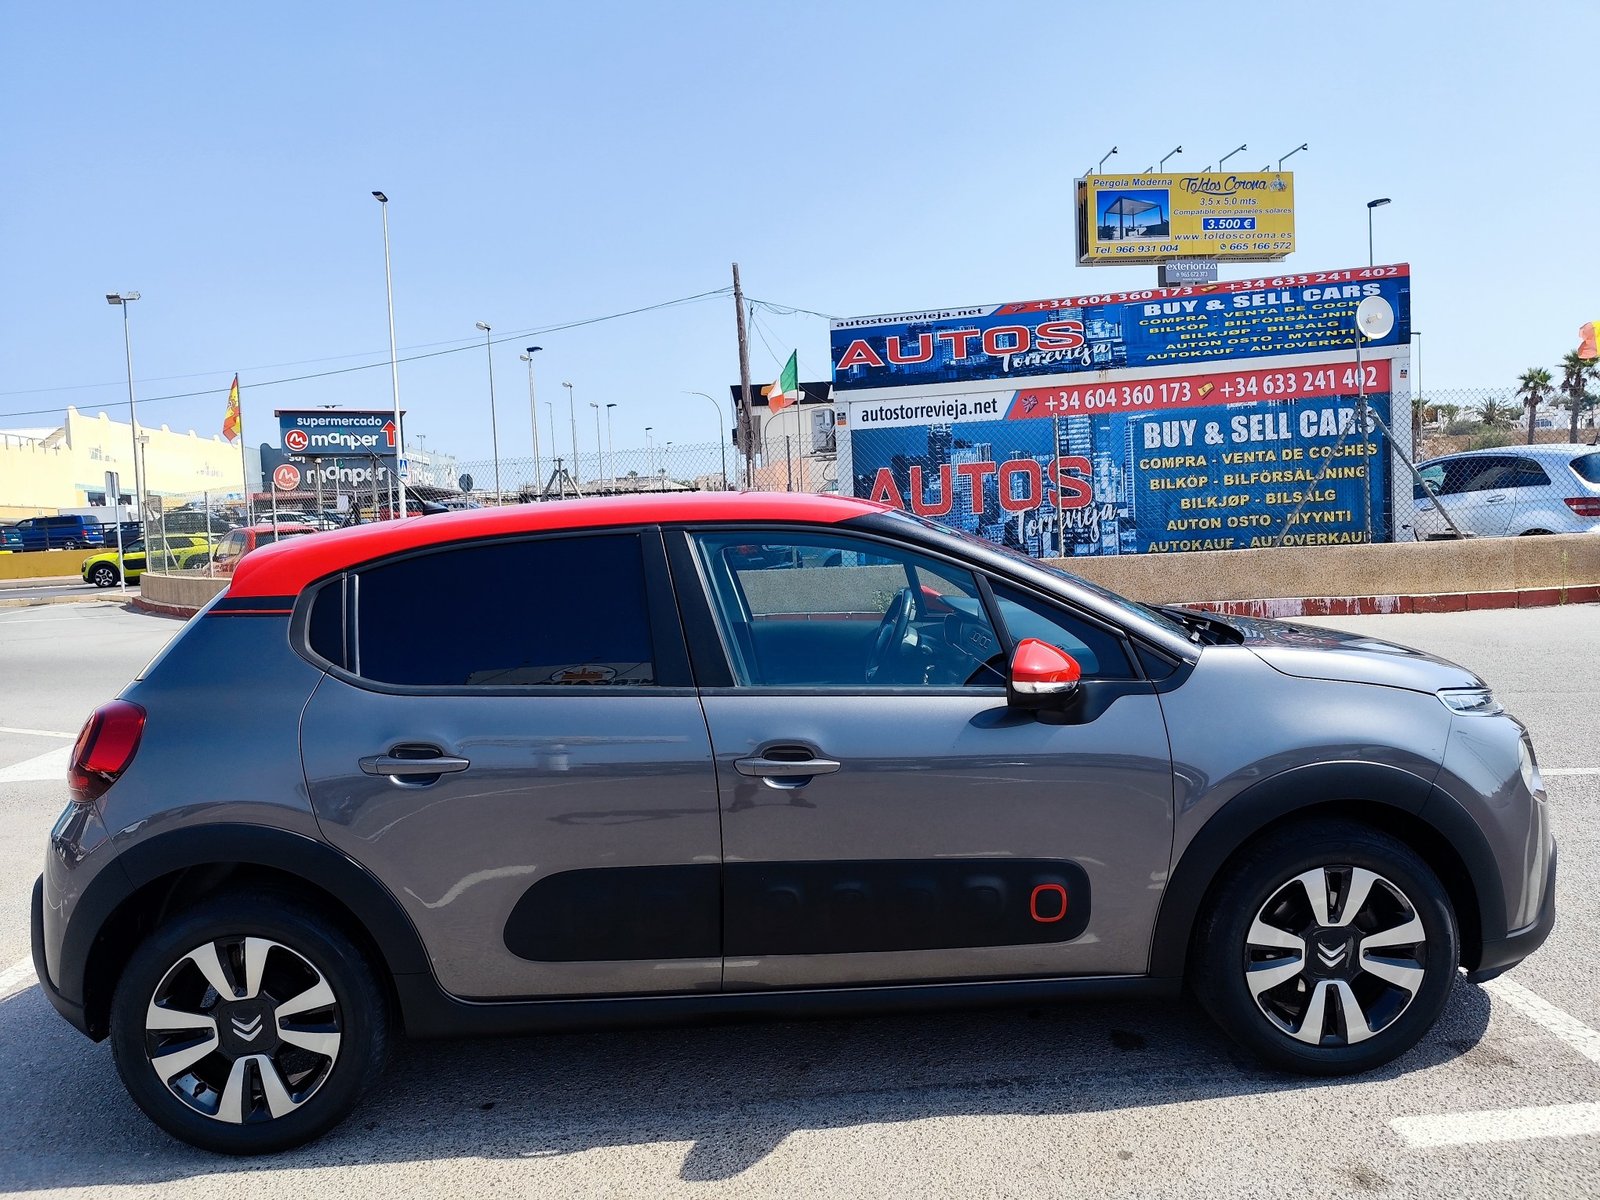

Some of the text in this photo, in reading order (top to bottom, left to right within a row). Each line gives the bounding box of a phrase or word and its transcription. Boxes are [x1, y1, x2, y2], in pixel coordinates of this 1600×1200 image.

[1132, 178, 1173, 186] Moderna
[1179, 175, 1267, 194] Toldos Corona
[1239, 197, 1259, 205] mts.
[1207, 219, 1252, 229] 3.500 €
[1174, 231, 1292, 240] www.toldoscorona.es
[1094, 244, 1179, 254] Tel. 966 931 004
[1229, 241, 1292, 250] 665 166 572
[1166, 261, 1217, 271] exterioriza
[1035, 267, 1398, 310] +34 604 360 173 +34 633 241 402
[1144, 283, 1381, 317] BUY & SELL CARS
[836, 308, 983, 328] autostorrevieja.net
[1139, 314, 1208, 326] COMPRA
[1223, 308, 1278, 318] VENTA
[1284, 305, 1305, 313] DE
[1312, 301, 1360, 310] COCH
[1149, 323, 1209, 334] BILKÖP
[1181, 328, 1251, 340] BILKJØP
[1267, 321, 1339, 332] BILSALG
[836, 319, 1086, 370] AUTOS
[1166, 340, 1222, 350] AUTON
[1228, 336, 1272, 345] OSTO
[1289, 329, 1354, 339] MYYNTI
[1000, 343, 1110, 372] Torrevieja
[1146, 347, 1234, 360] AUTOKAUF
[1045, 390, 1080, 412] +34
[1084, 387, 1117, 409] 604
[1121, 384, 1154, 406] 360
[1159, 381, 1191, 403] 173
[1220, 376, 1258, 398] +34
[1263, 372, 1297, 394] 633
[1302, 369, 1335, 391] 241
[1342, 366, 1377, 388] 402
[861, 398, 998, 422] autostorrevieja.net
[297, 416, 382, 428] supermercado
[1144, 420, 1197, 449] BUY
[1204, 421, 1224, 445] &
[1231, 412, 1292, 443] SELL
[311, 432, 379, 450] manper
[1139, 455, 1207, 470] COMPRA
[1222, 450, 1276, 465] VENTA
[1282, 448, 1303, 461] DE
[1309, 443, 1377, 460] COCHES
[306, 466, 387, 487] manper
[1150, 474, 1208, 490] BILKÖP
[869, 456, 1092, 517] AUTOS
[1181, 495, 1250, 509] BILKJØP
[1167, 517, 1222, 531] AUTON
[1227, 515, 1271, 528] OSTO
[1286, 510, 1352, 525] MYYNTI
[1148, 537, 1234, 553] AUTOKAUF
